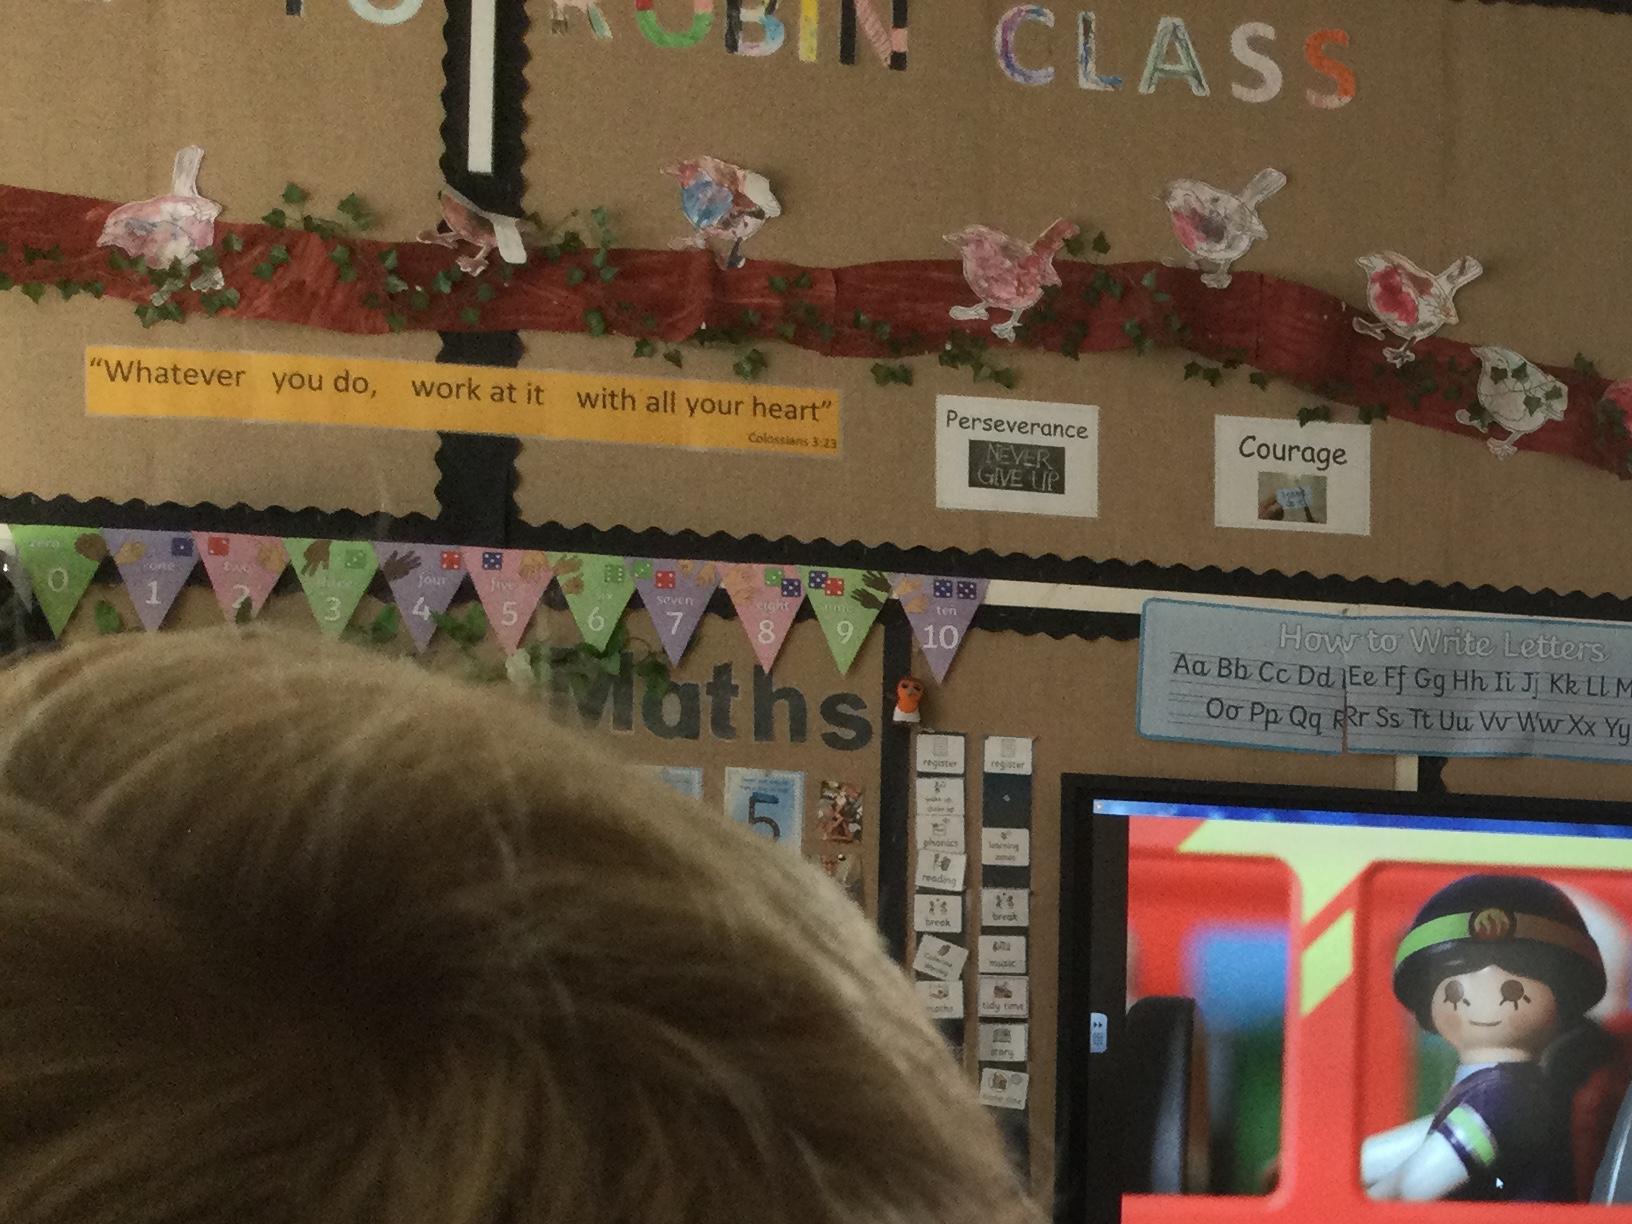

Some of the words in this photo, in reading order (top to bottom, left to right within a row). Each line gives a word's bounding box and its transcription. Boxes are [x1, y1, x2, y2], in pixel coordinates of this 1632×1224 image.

[995, 3, 1358, 109] CLASS
[272, 370, 323, 395] you
[333, 369, 377, 399] do,
[411, 376, 481, 400] work
[490, 382, 517, 403] at
[526, 382, 545, 405] it
[576, 386, 637, 412] with
[646, 390, 676, 414] all
[686, 395, 745, 418] your
[946, 410, 1089, 440] Perseverance
[747, 431, 808, 447] Colossians
[812, 436, 838, 449] 3:23
[1238, 435, 1348, 471] Courage
[985, 441, 1053, 470] NEVER
[977, 466, 1023, 489] GIVE
[1031, 470, 1060, 492] UP
[48, 567, 69, 593] 0
[145, 579, 161, 605] 1
[417, 571, 447, 590] four
[489, 577, 517, 592] five
[231, 583, 251, 609] 2
[324, 596, 342, 622] 3
[412, 596, 432, 620] 4
[655, 594, 695, 606] seven
[757, 600, 789, 615] eight
[500, 601, 518, 627] 5
[586, 606, 605, 632] 6
[667, 611, 683, 635] 7
[936, 604, 958, 616] ten
[758, 619, 775, 645] 8
[836, 620, 854, 645] 9
[923, 623, 960, 650] 10
[1279, 623, 1359, 653] How
[1367, 628, 1402, 653] to
[1409, 626, 1496, 657] Write
[1504, 631, 1610, 664] Letters
[1173, 652, 1211, 677] Aa
[1217, 656, 1252, 680] Bb
[1258, 660, 1292, 685] Cc
[1298, 663, 1337, 689] Dd
[1384, 665, 1408, 695] Ff
[1414, 667, 1446, 697] Gg
[1453, 669, 1489, 693] Hh
[1493, 671, 1513, 692] Ii
[1521, 671, 1541, 700] Jj
[1550, 673, 1582, 695] Kk
[1587, 675, 1610, 698] Ll
[549, 643, 874, 753] Maths
[1206, 697, 1244, 720] Oo
[1250, 701, 1282, 731] Pp
[1289, 704, 1323, 735] Qq
[1375, 706, 1402, 729] Ss
[1409, 707, 1435, 730] Tt
[1439, 709, 1474, 732] Uu
[1480, 710, 1513, 732] Vv
[1517, 710, 1564, 734] Ww
[1567, 713, 1598, 737] Xx
[1604, 716, 1631, 746] Yy
[923, 758, 957, 771] register
[990, 759, 1025, 771] register
[922, 837, 959, 849] phonics
[922, 874, 957, 887] reading
[925, 918, 951, 927] break
[992, 911, 1018, 922] break
[988, 959, 1016, 968] music
[982, 1000, 1001, 1013] tidy
[1003, 1001, 1024, 1011] time
